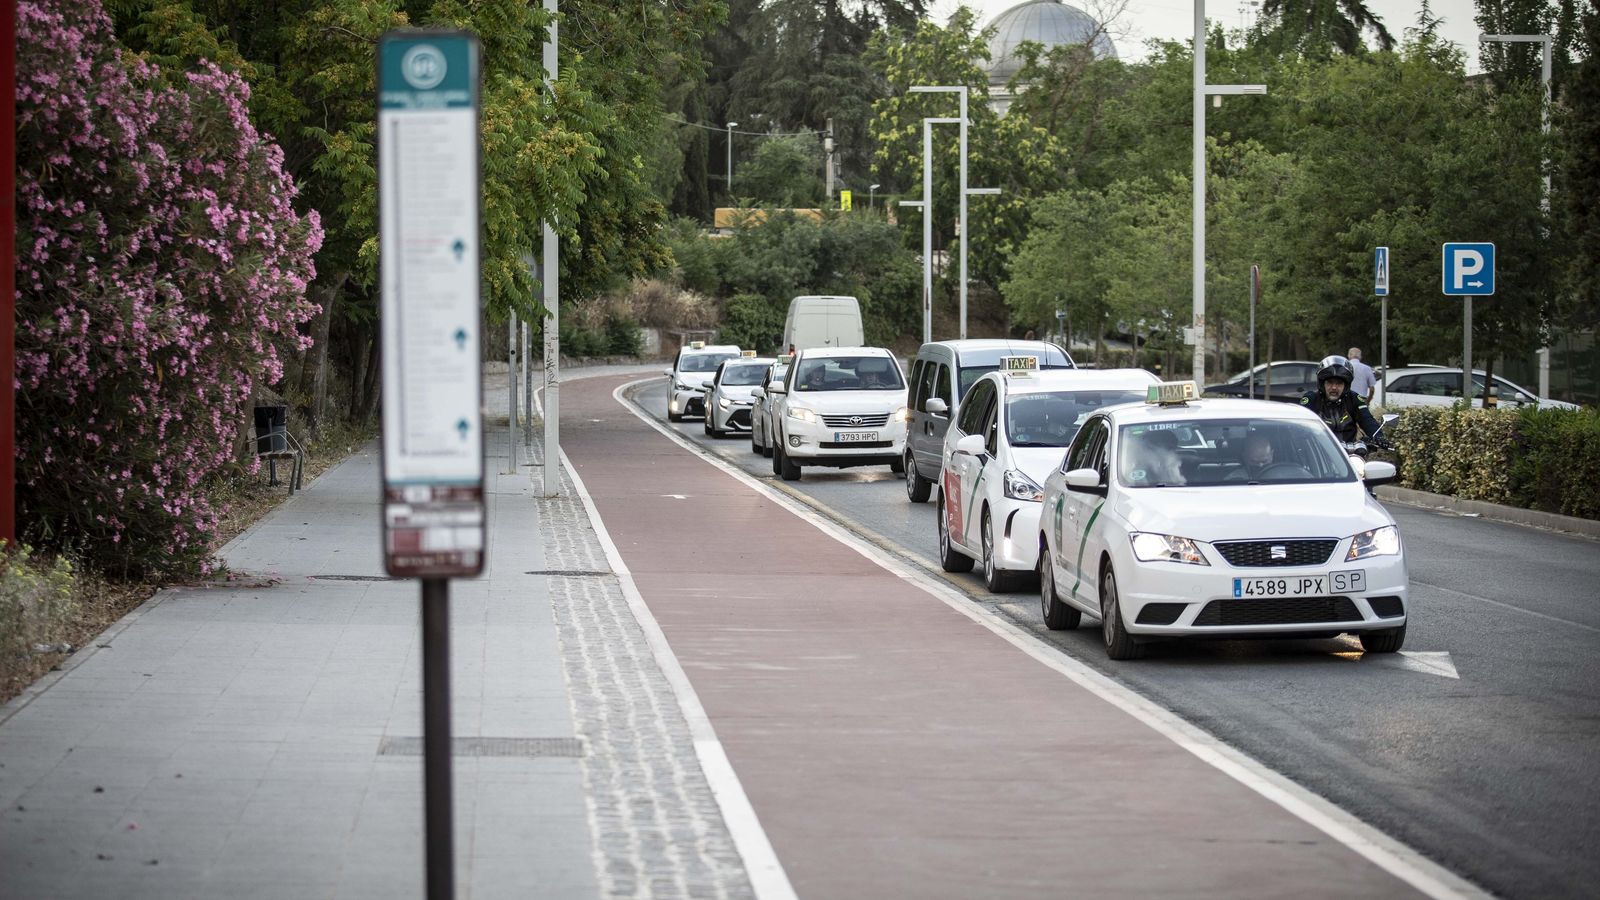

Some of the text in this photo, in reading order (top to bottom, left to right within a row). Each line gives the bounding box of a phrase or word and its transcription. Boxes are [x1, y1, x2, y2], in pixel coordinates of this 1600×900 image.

[1454, 249, 1484, 289] P
[841, 433, 876, 441] 3793 HPC
[1245, 580, 1287, 595] 4589
[1293, 578, 1323, 594] JPX
